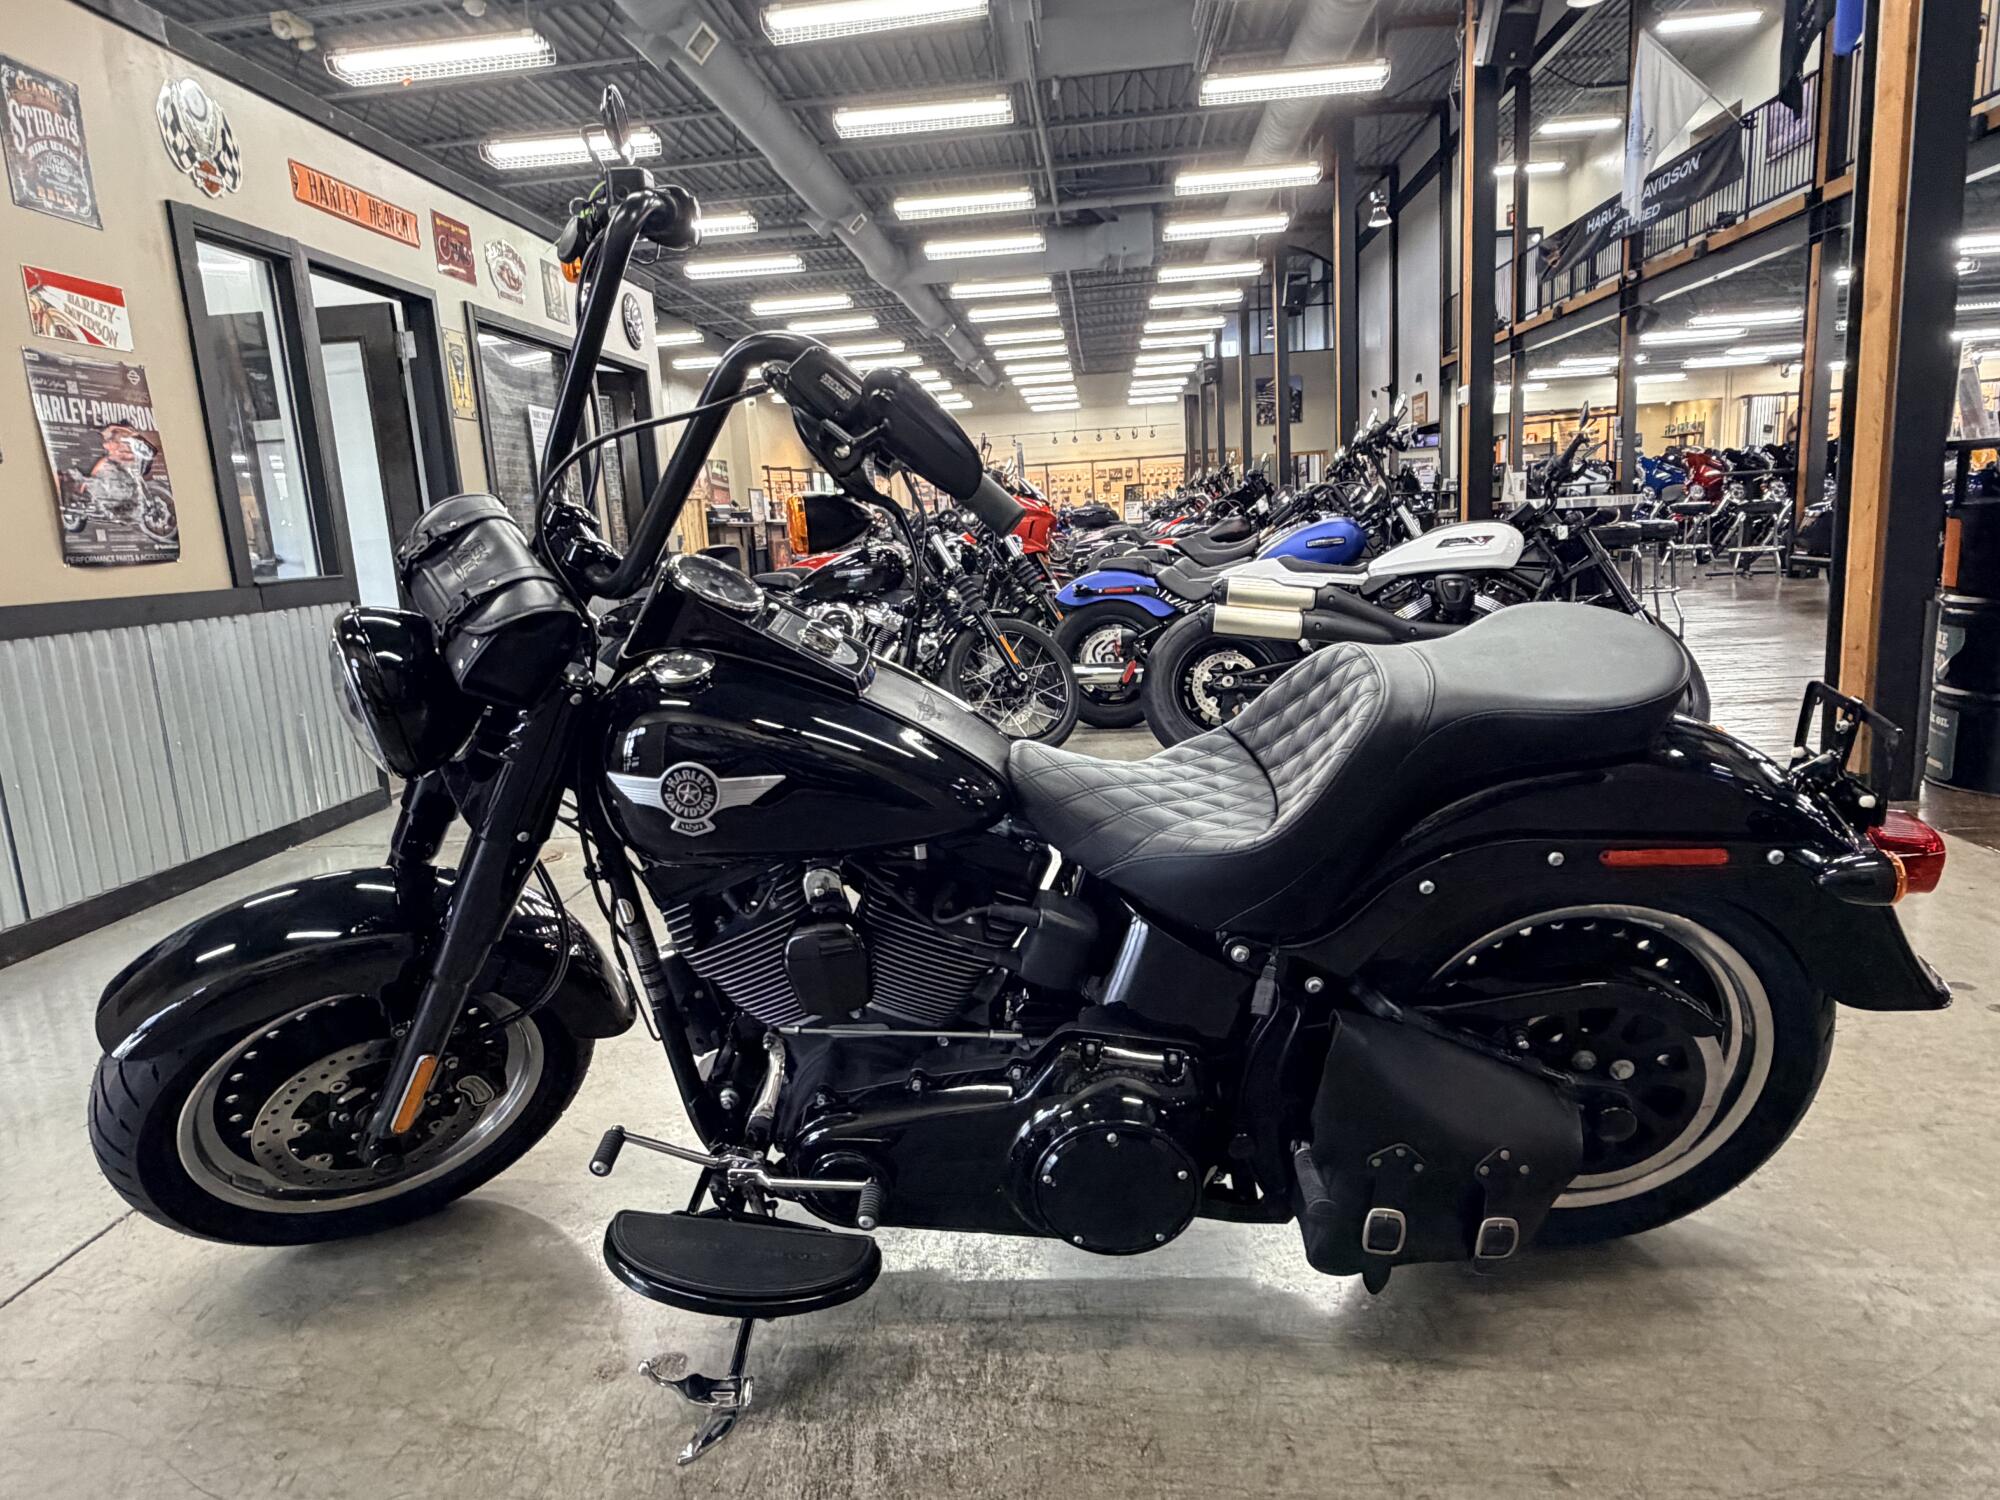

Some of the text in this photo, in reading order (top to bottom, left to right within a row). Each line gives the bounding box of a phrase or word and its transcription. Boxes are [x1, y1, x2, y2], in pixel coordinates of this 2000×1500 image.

[8, 98, 80, 154] STURGIS
[307, 170, 411, 240] HARLEY HEAVEN
[63, 303, 119, 348] DAVIDSON
[66, 293, 121, 323] HARLEY-
[32, 391, 159, 432] HARLEY-DAVIDSON
[666, 769, 711, 789] HARLEY
[664, 793, 714, 817] DAVIDSON
